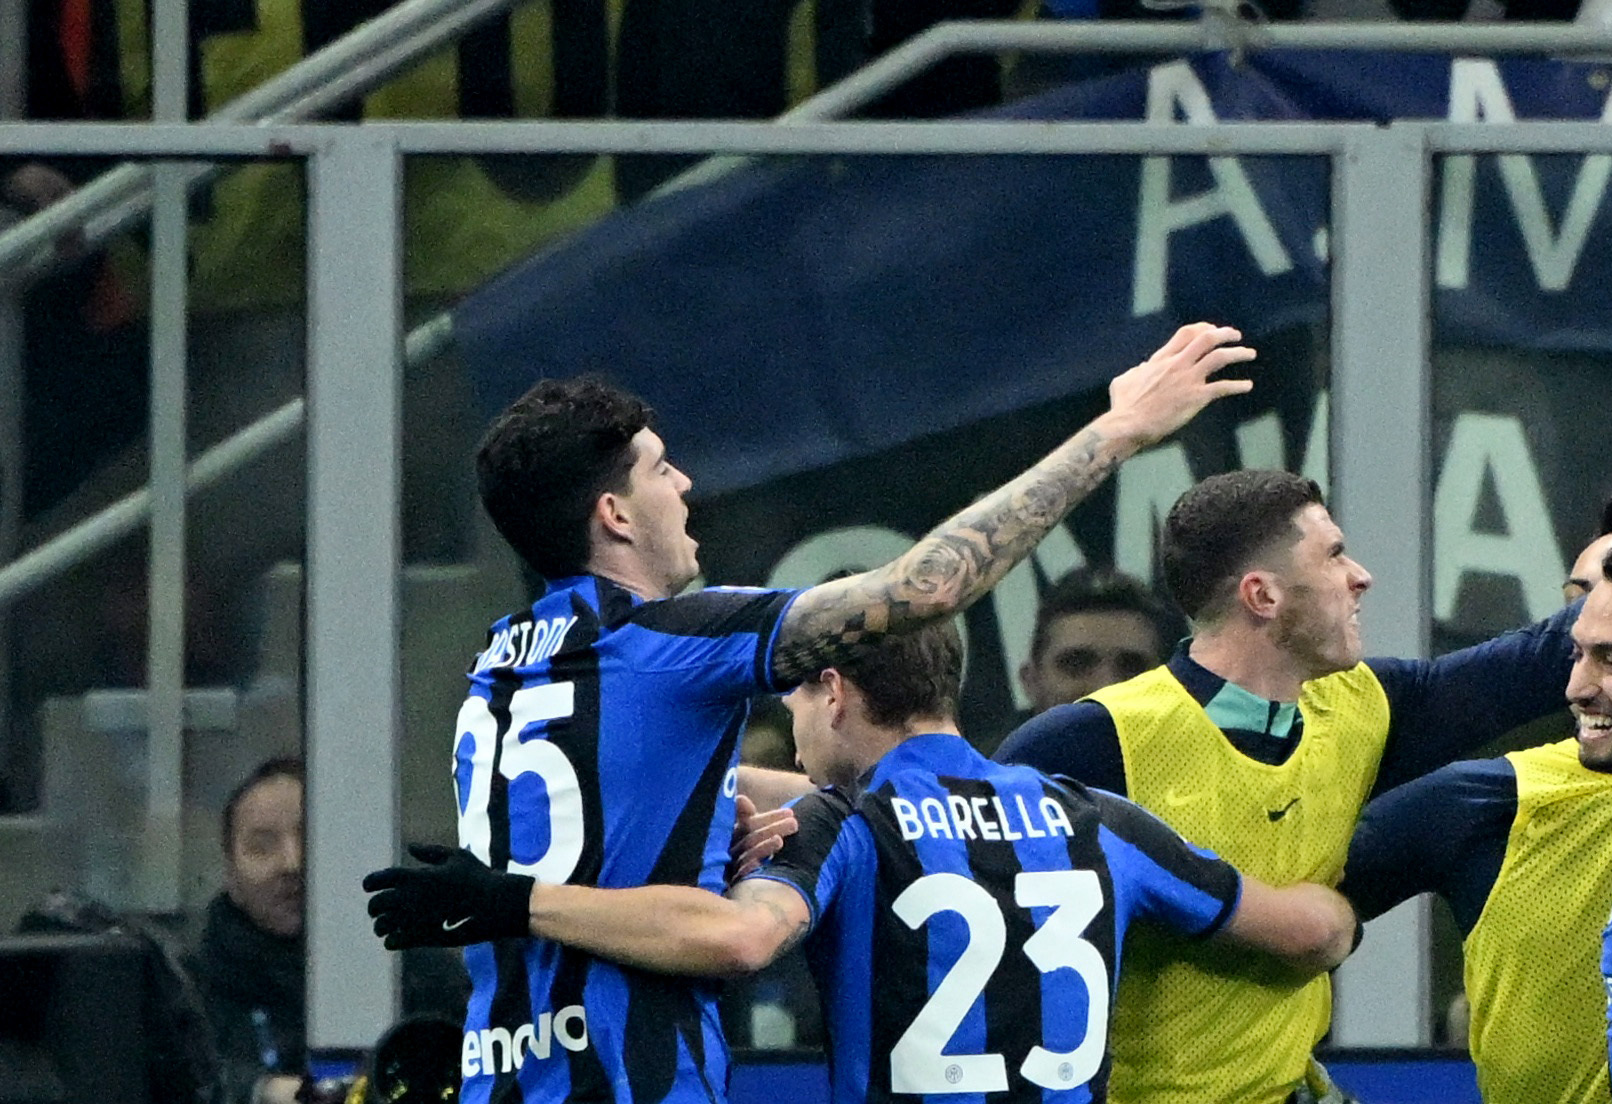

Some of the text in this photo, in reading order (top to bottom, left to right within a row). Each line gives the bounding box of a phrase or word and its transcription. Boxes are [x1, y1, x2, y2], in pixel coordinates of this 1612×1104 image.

[891, 796, 1075, 842] BARELLA
[890, 869, 1112, 1094] 23
[461, 1005, 589, 1078] enovo
